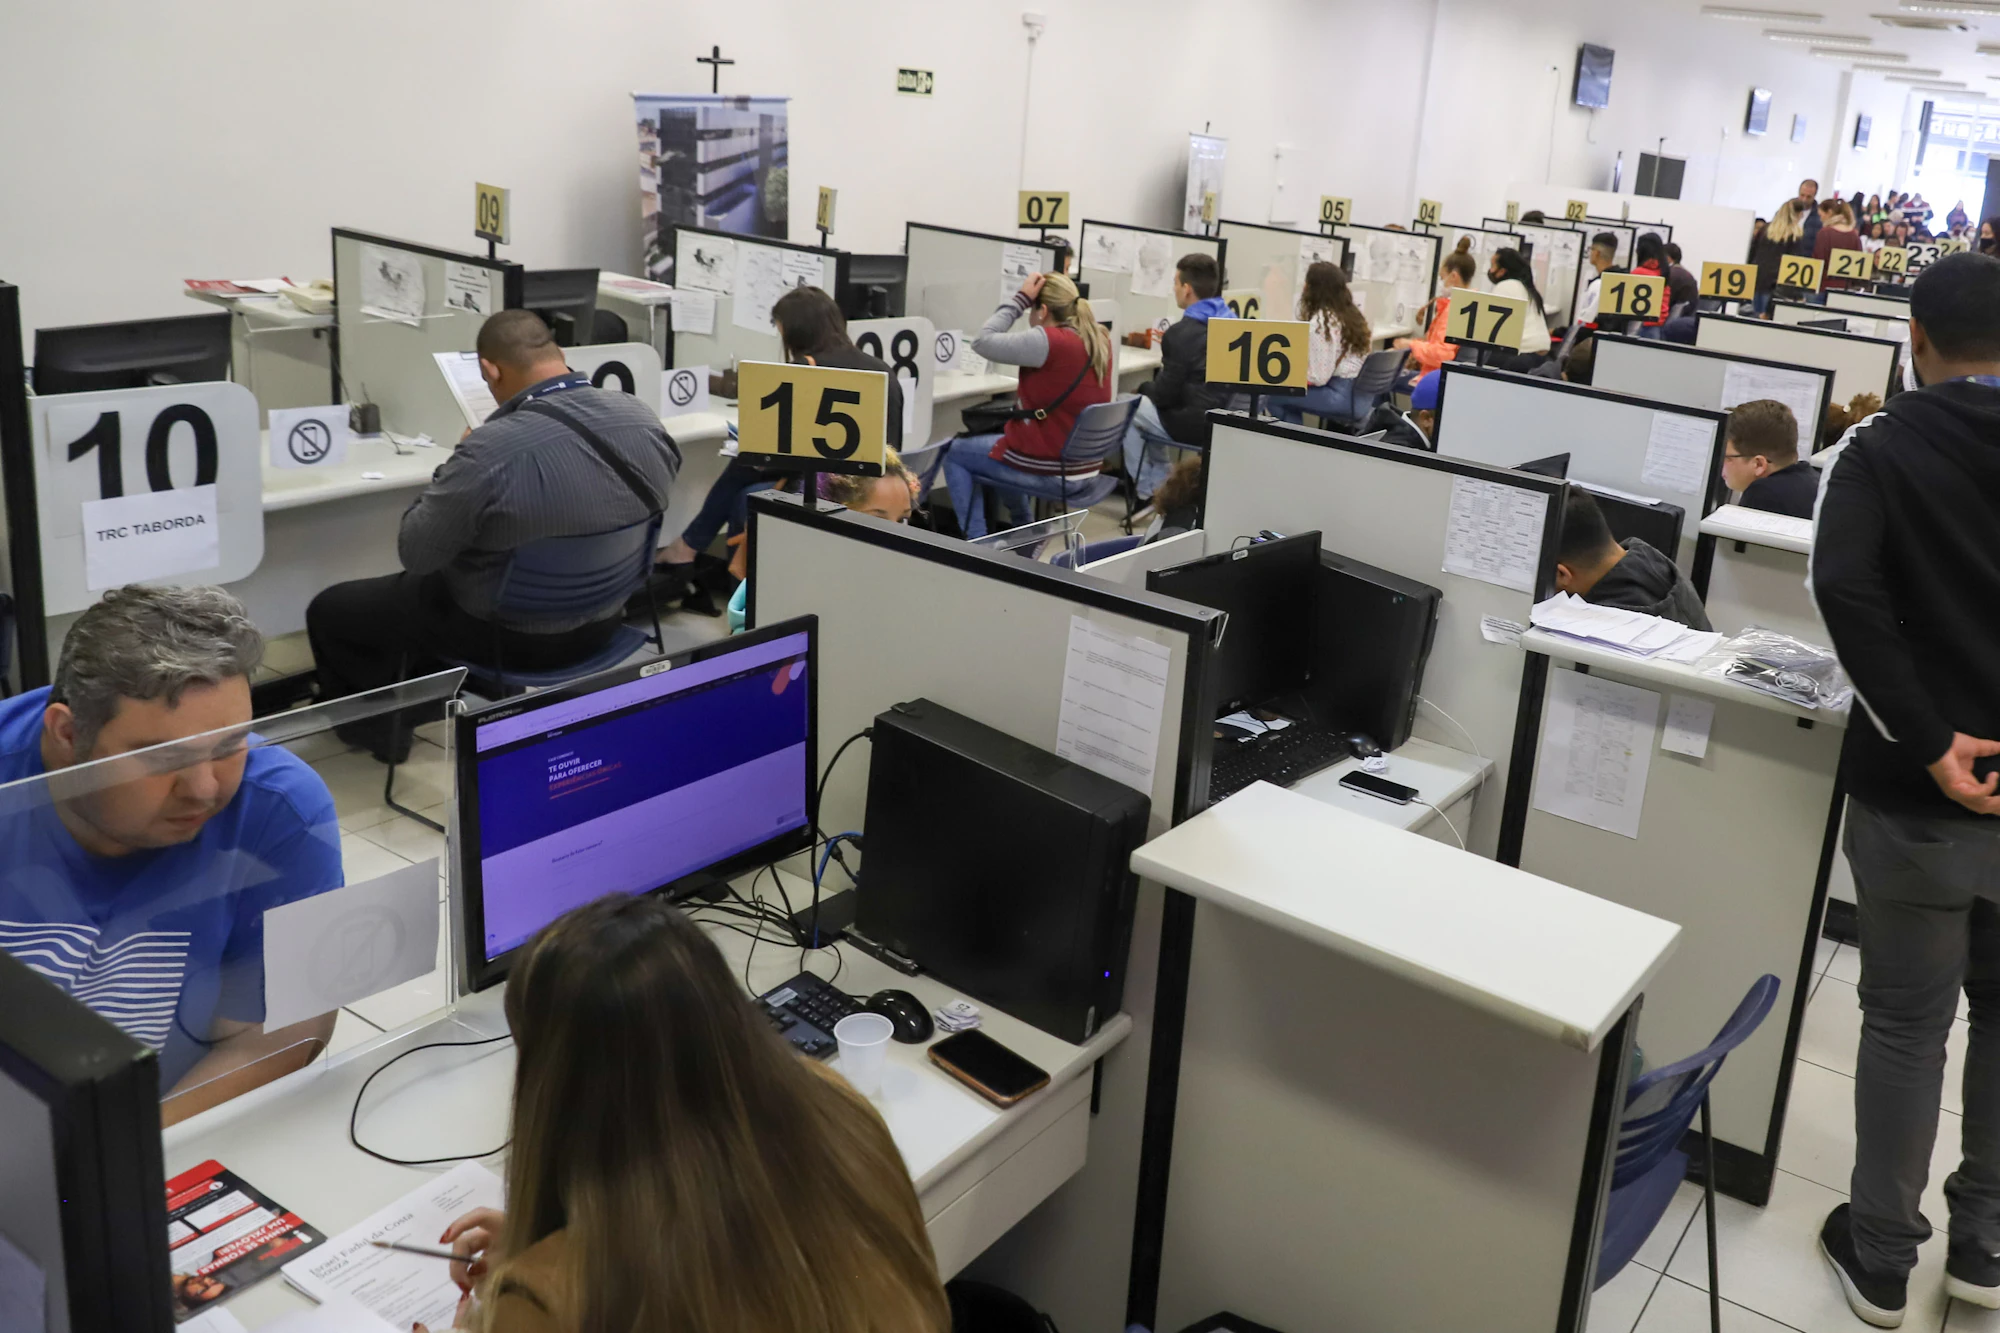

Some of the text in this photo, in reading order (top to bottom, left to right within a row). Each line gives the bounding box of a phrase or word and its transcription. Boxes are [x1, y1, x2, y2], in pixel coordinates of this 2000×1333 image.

[479, 191, 500, 234] 09
[1026, 196, 1063, 223] 07
[1323, 200, 1344, 221] 05
[1420, 203, 1435, 222] 04
[1568, 203, 1583, 218] 02
[1835, 254, 1867, 277] 21
[1881, 251, 1902, 271] 22
[1908, 245, 1939, 265] 23
[1708, 267, 1746, 297] 19
[1784, 261, 1814, 288] 20
[1610, 281, 1653, 316] 18
[1459, 300, 1514, 343] 17
[1228, 331, 1291, 385] 16
[760, 381, 861, 459] 15
[67, 402, 218, 499] 10
[97, 514, 207, 541] TRC TABORDA
[548, 765, 557, 774] TE
[558, 757, 580, 770] OUVIR
[548, 759, 602, 782] PARA OFERECER
[267, 1217, 287, 1231] UM
[200, 1223, 294, 1274] VENHA SE TORNAR
[308, 1253, 340, 1277] Israel
[384, 1212, 414, 1233] Costa
